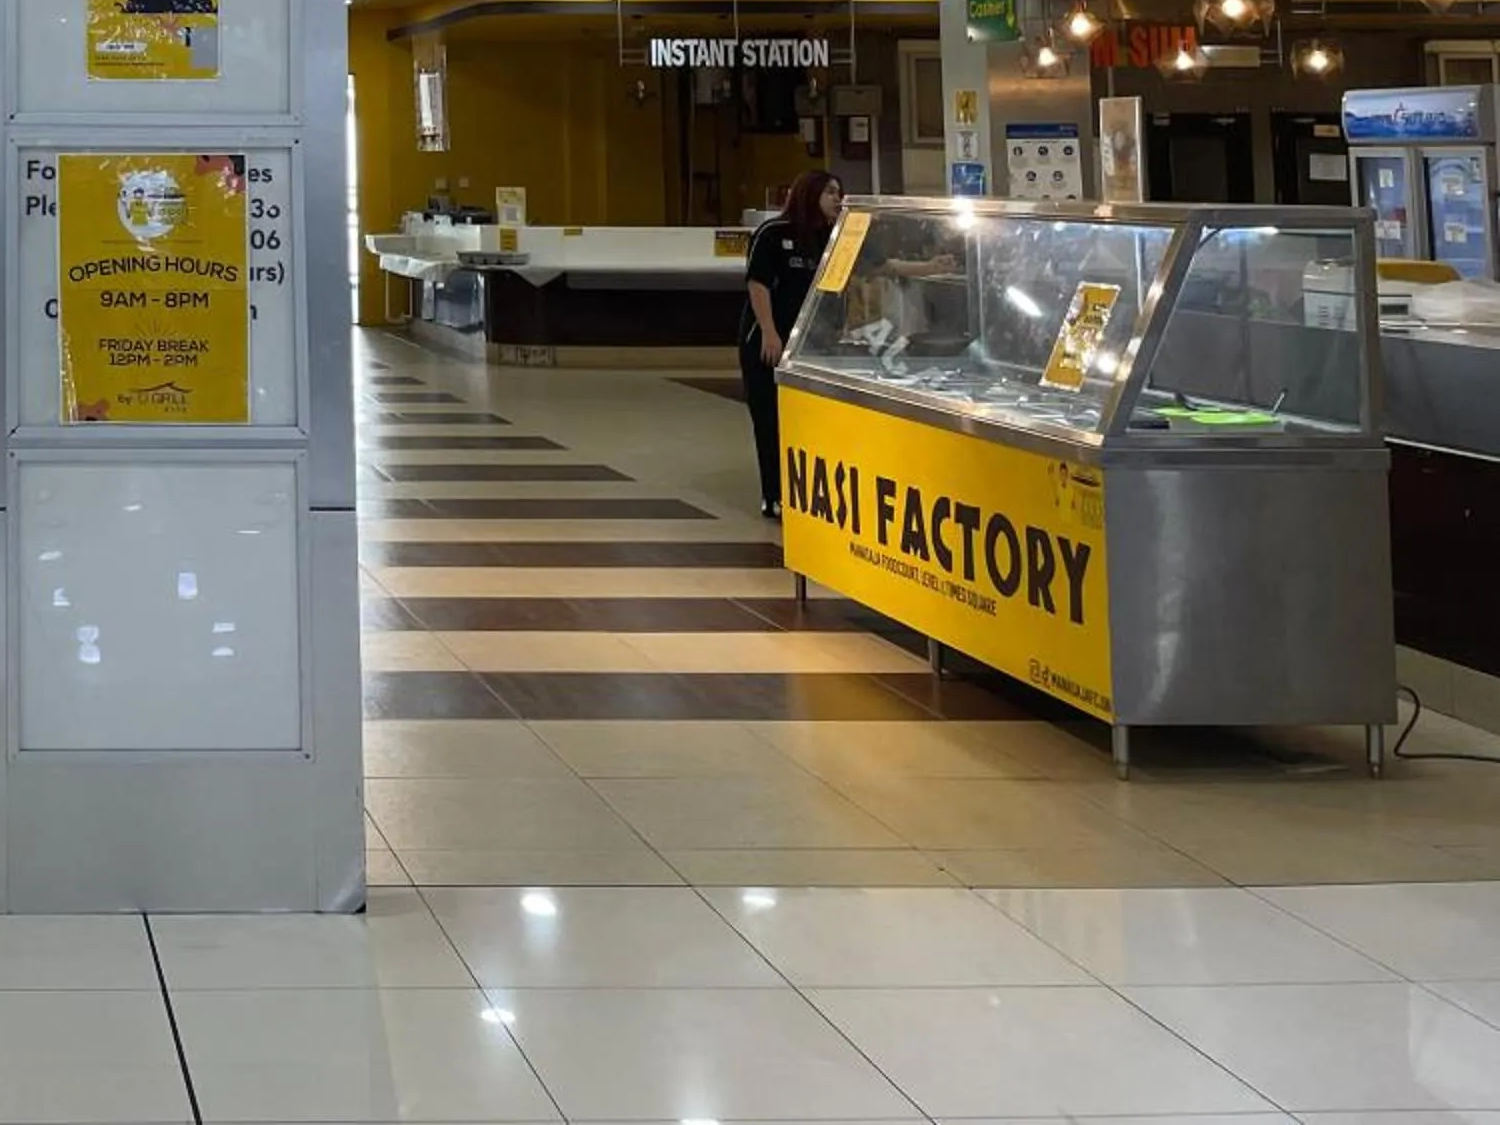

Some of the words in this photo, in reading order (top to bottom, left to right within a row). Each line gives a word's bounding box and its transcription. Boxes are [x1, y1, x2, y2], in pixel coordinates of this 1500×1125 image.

[651, 38, 738, 68] INSTANT
[742, 38, 829, 68] STATION
[69, 255, 161, 283] OPENING
[165, 257, 239, 282] HOURS
[100, 291, 147, 308] 9AM
[165, 291, 209, 308] 8PM
[99, 339, 153, 352] FRIDAY
[157, 339, 209, 352] BREAK
[109, 354, 150, 366] 12PM
[164, 354, 199, 366] 2PM
[787, 446, 861, 536] NASI
[875, 475, 1091, 625] FACTORY
